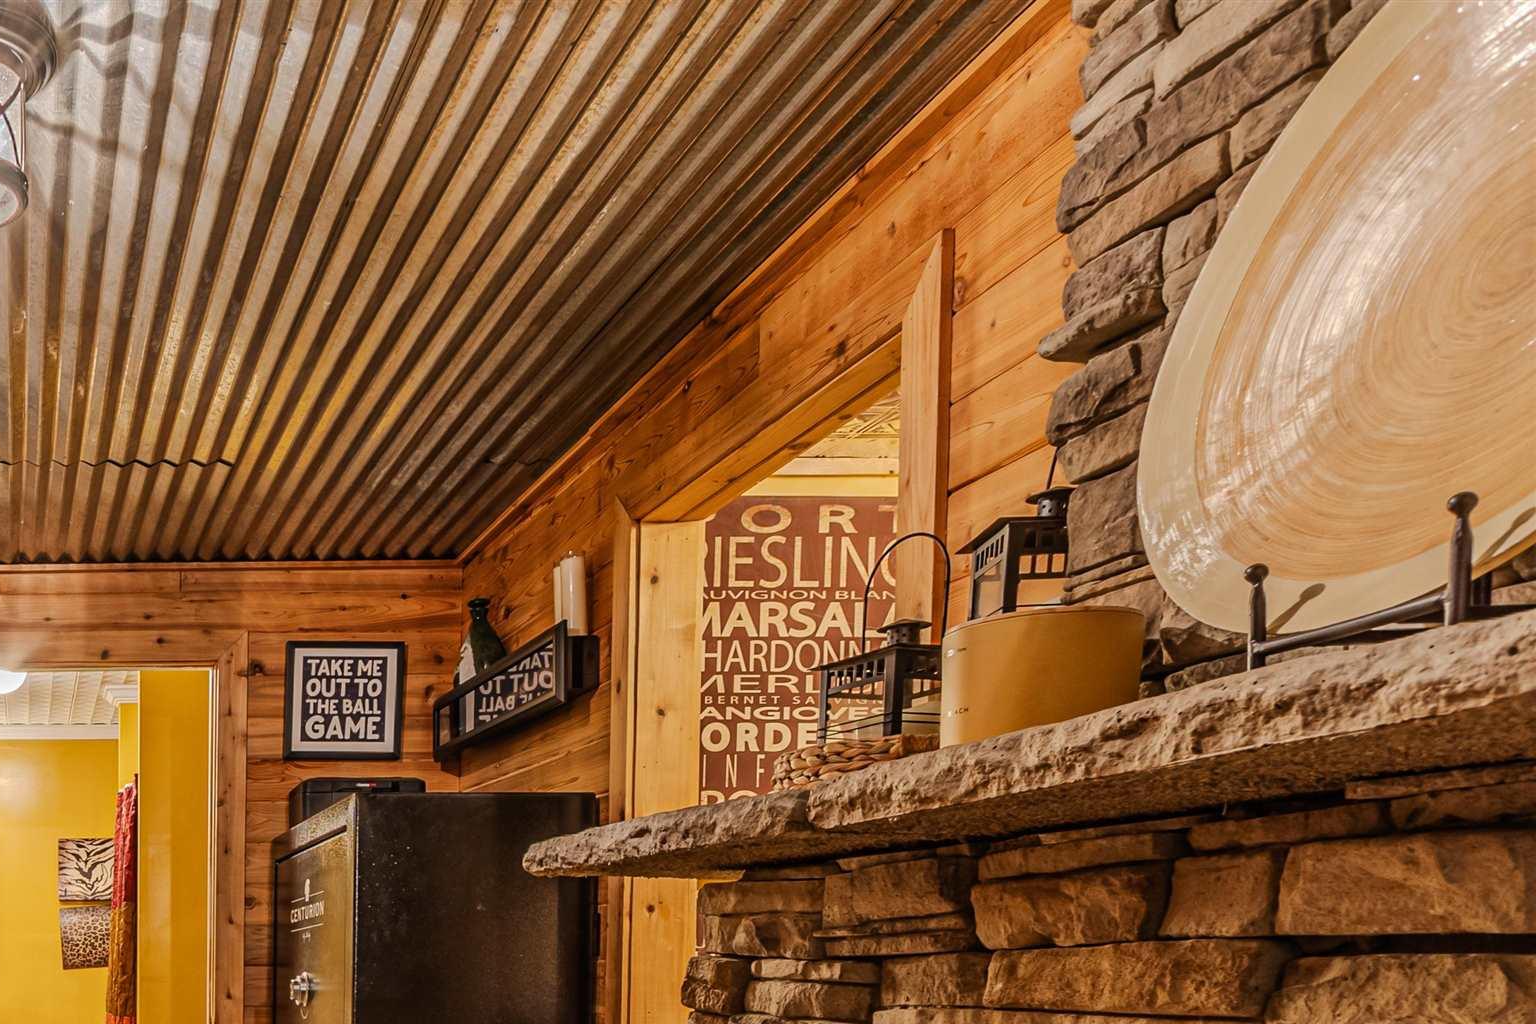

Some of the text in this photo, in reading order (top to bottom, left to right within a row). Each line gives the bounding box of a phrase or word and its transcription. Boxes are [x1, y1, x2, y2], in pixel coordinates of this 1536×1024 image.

[307, 659, 383, 677] TAKE ME
[305, 678, 383, 697] OUT TO
[306, 699, 381, 715] THE BALL
[304, 715, 380, 740] GAME
[291, 900, 325, 923] CENTURION
